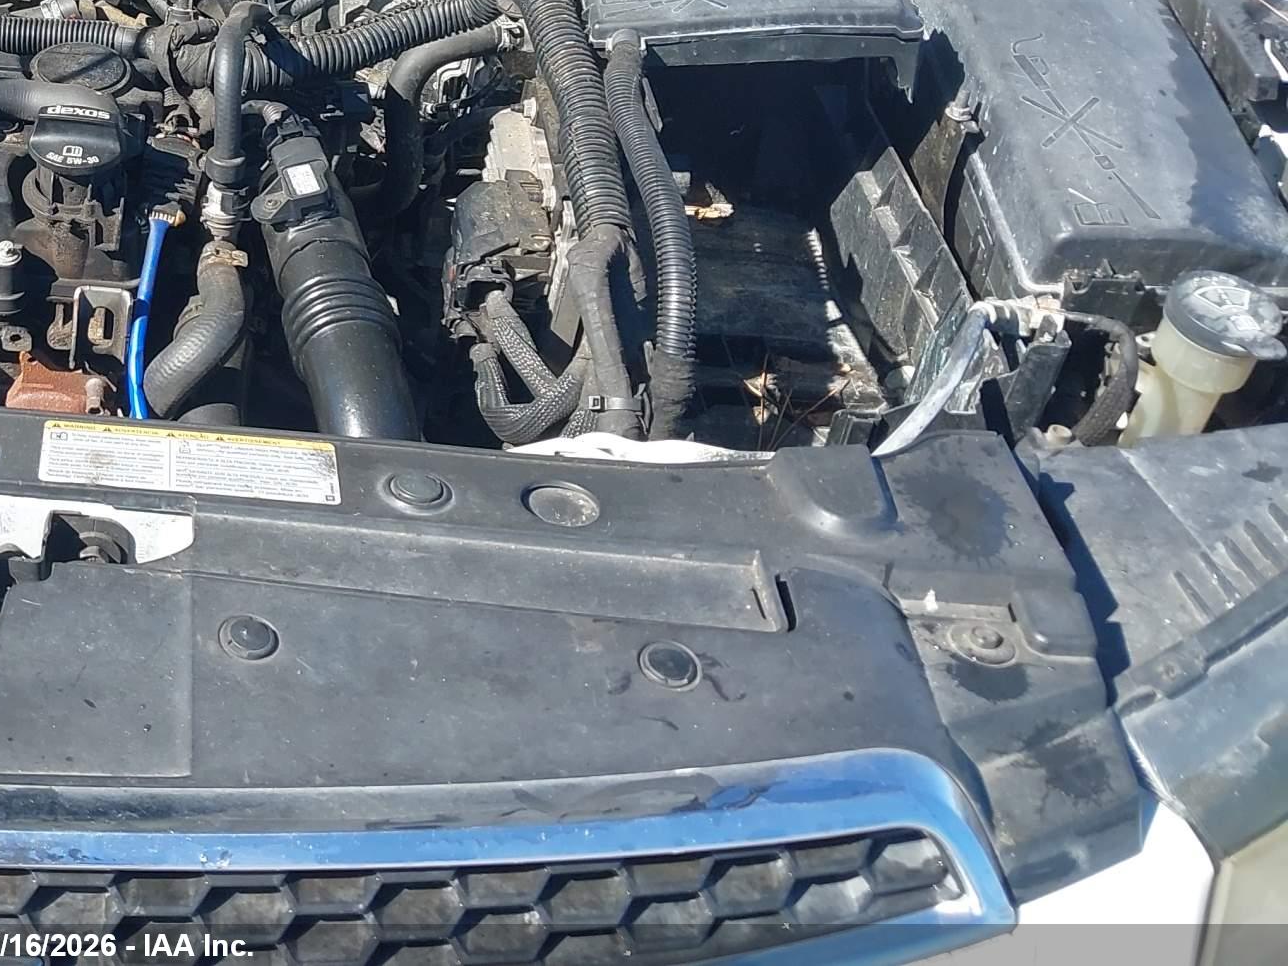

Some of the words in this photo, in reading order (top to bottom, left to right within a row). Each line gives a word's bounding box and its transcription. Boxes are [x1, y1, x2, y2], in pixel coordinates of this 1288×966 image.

[47, 105, 110, 119] dexos
[46, 151, 65, 163] SAE
[66, 155, 100, 165] 5W-30
